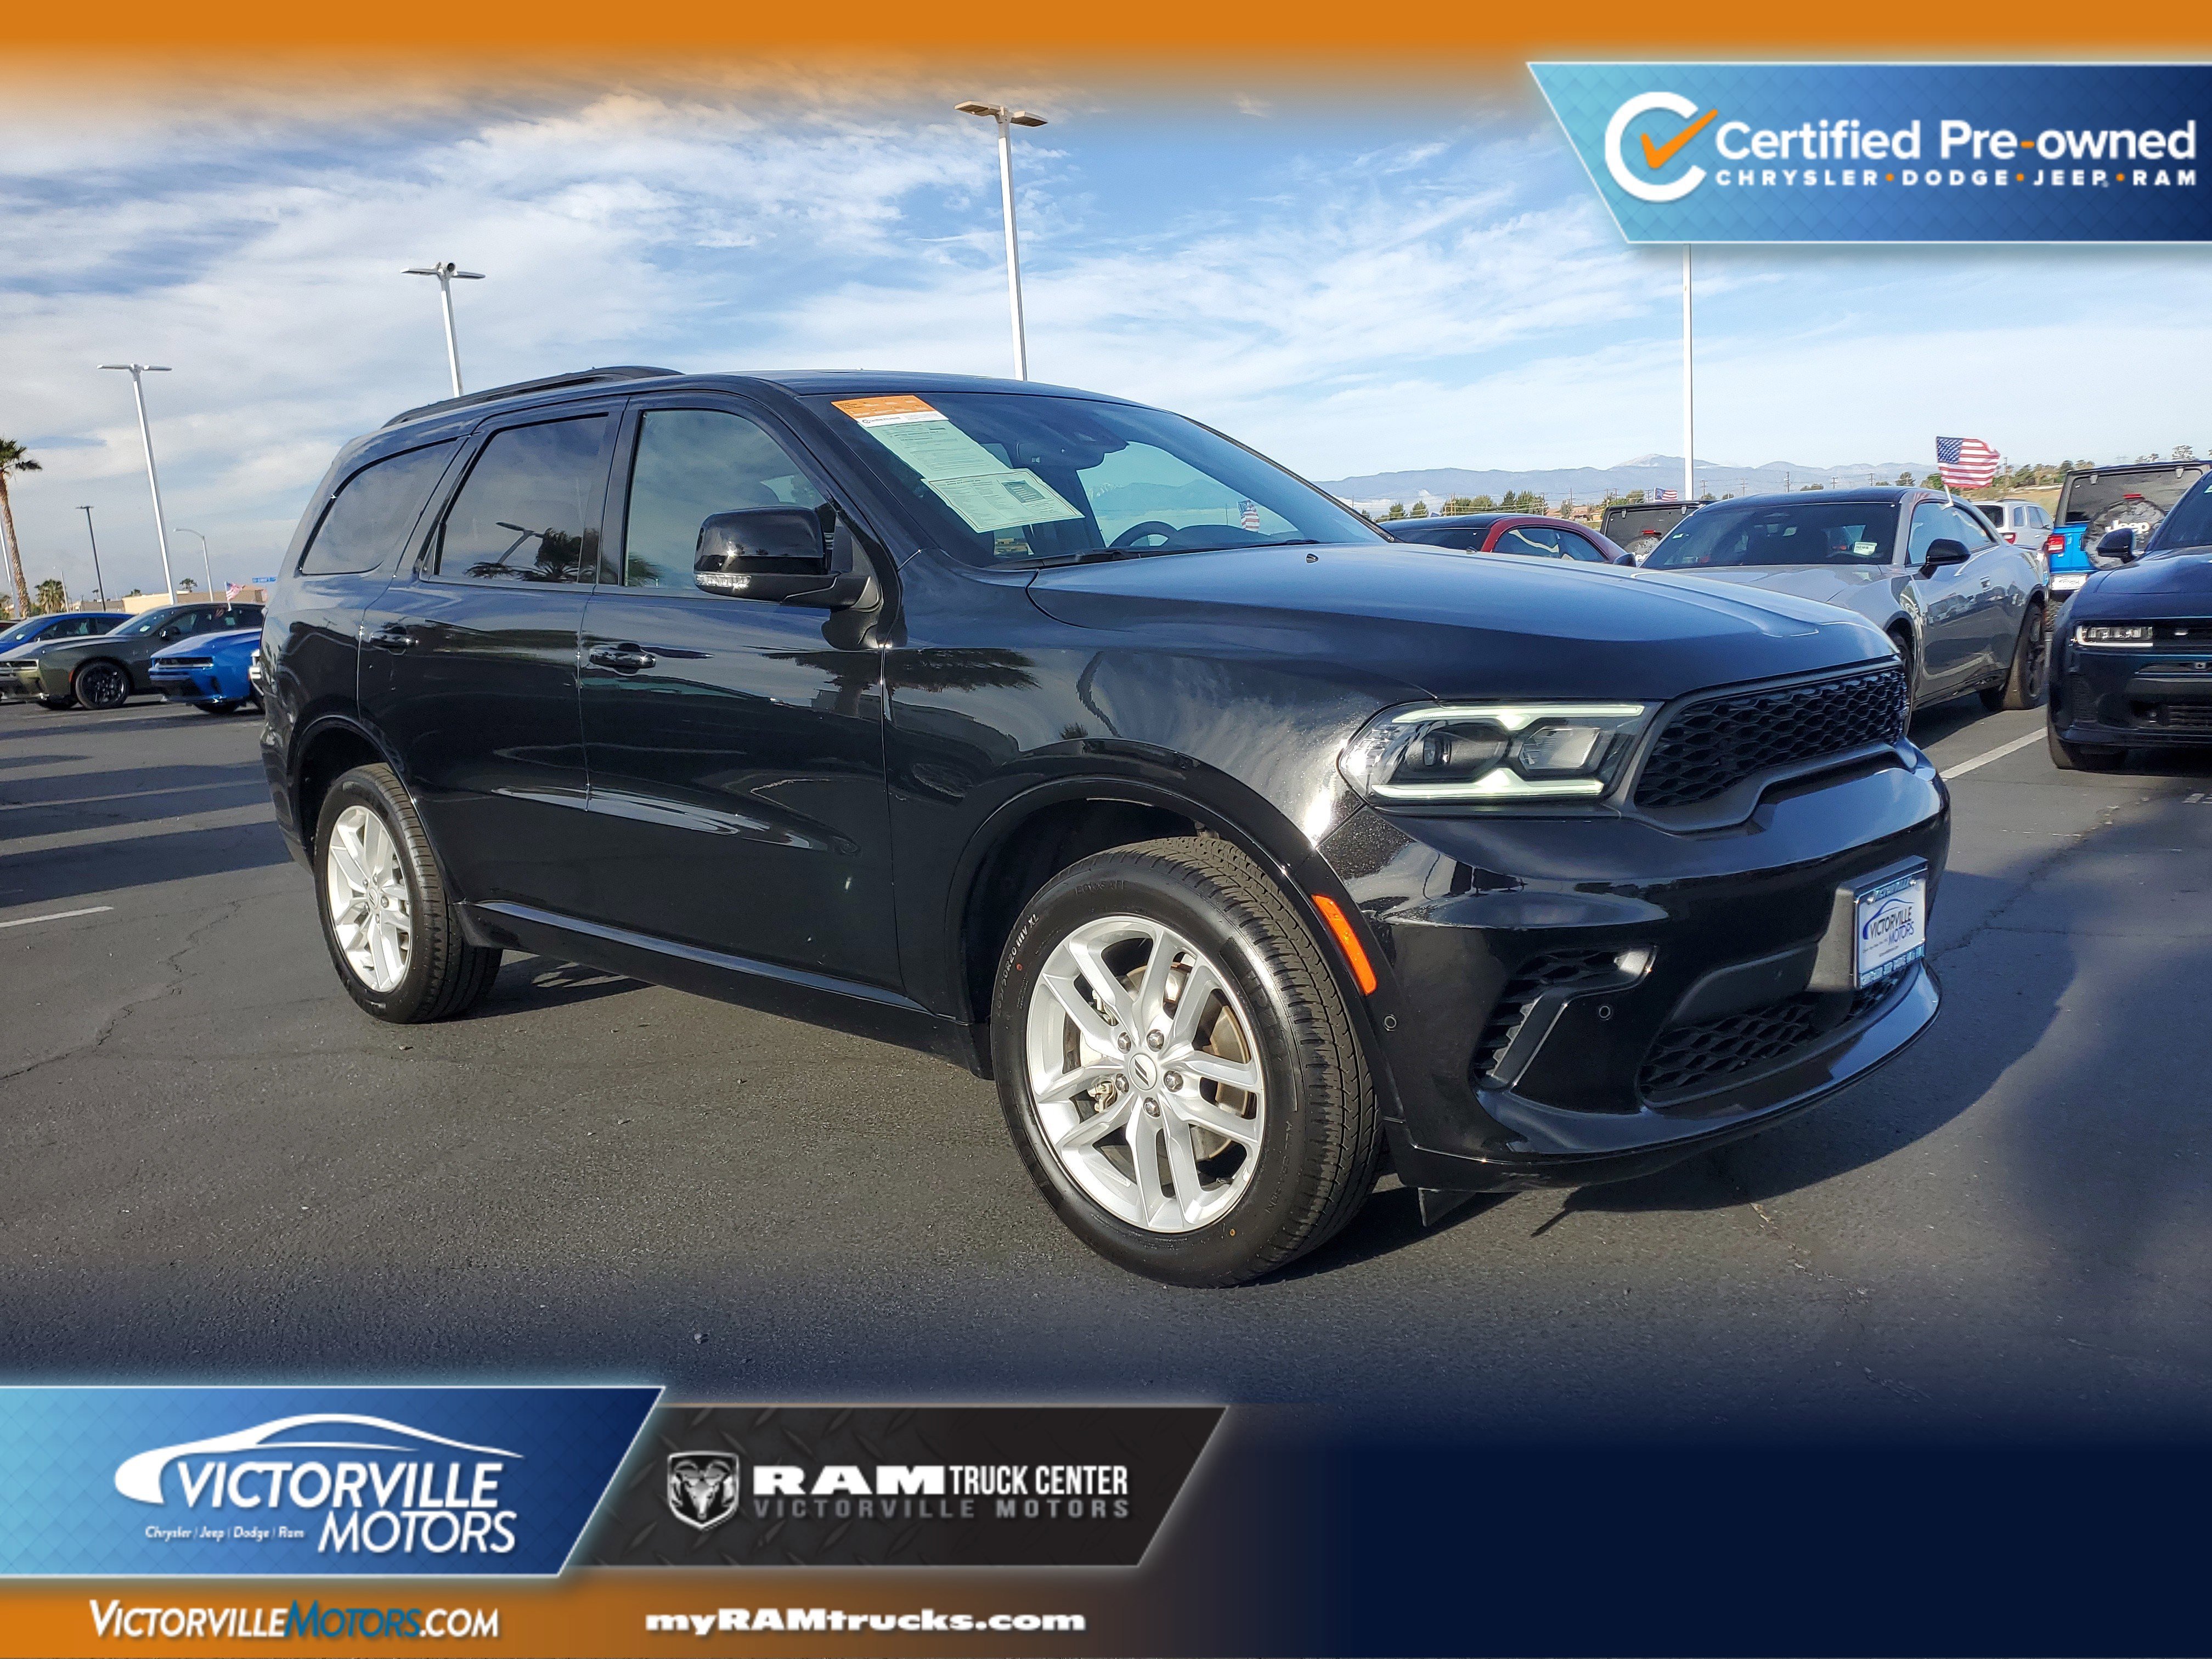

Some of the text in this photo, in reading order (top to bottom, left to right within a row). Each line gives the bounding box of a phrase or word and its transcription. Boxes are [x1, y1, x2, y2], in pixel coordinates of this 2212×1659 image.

[2105, 520, 2150, 534] Jeep
[1870, 906, 1912, 940] VICTORVILLE
[1888, 921, 1915, 945] MOTORS
